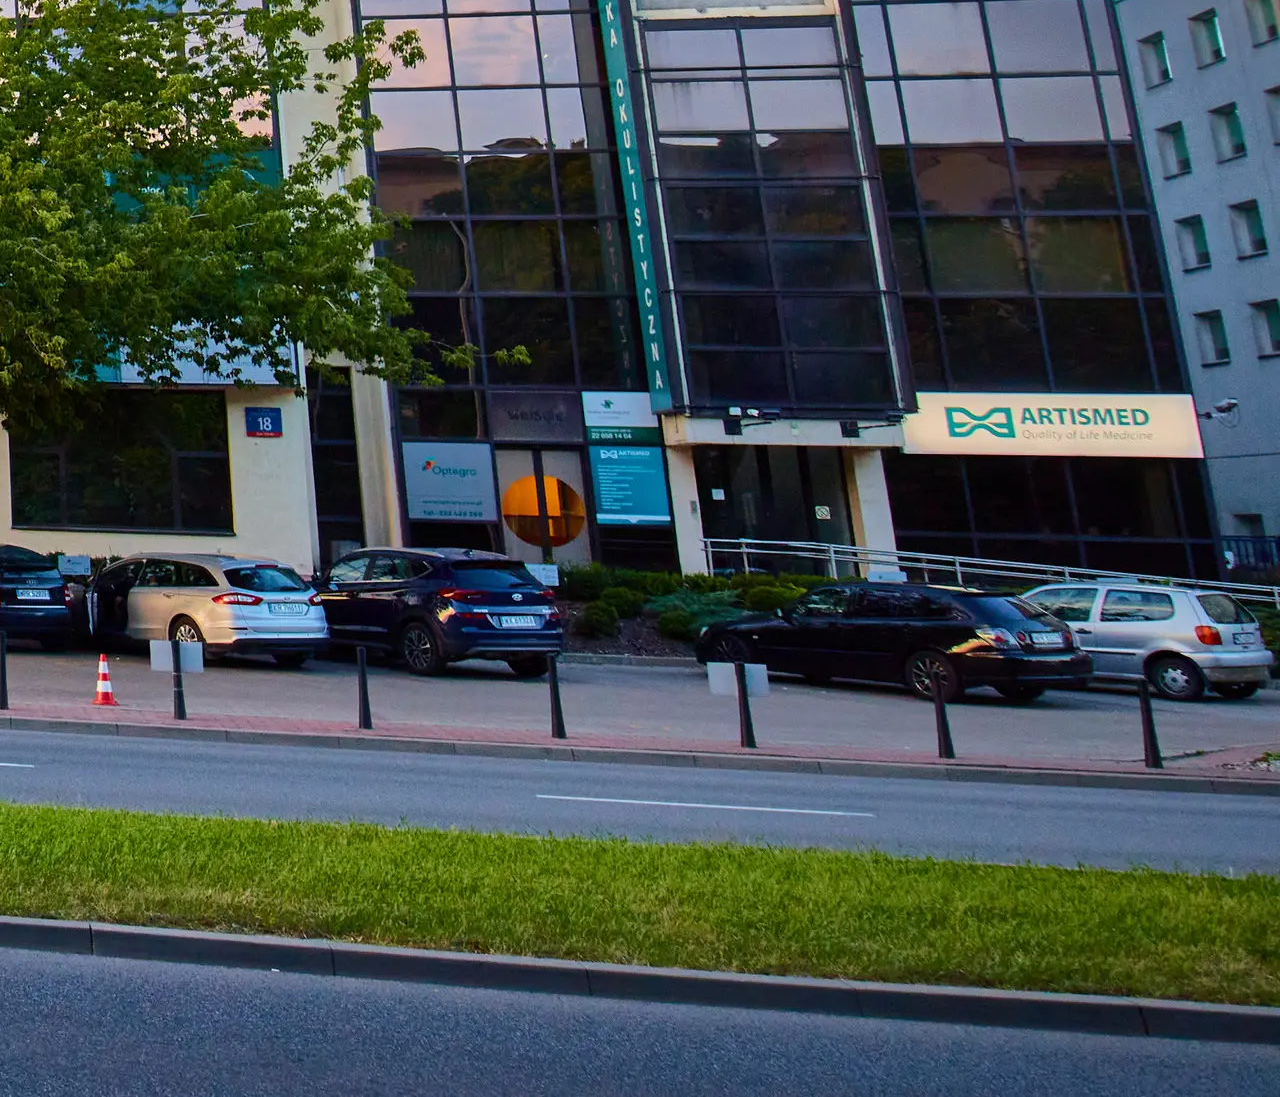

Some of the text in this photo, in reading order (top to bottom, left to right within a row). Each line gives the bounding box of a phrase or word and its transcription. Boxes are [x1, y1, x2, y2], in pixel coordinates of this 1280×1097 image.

[615, 77, 664, 390] OKULISTYCZNA
[257, 417, 272, 431] 18
[1020, 407, 1150, 426] ARTISMED
[1022, 430, 1153, 441] Quality of Life Medicine
